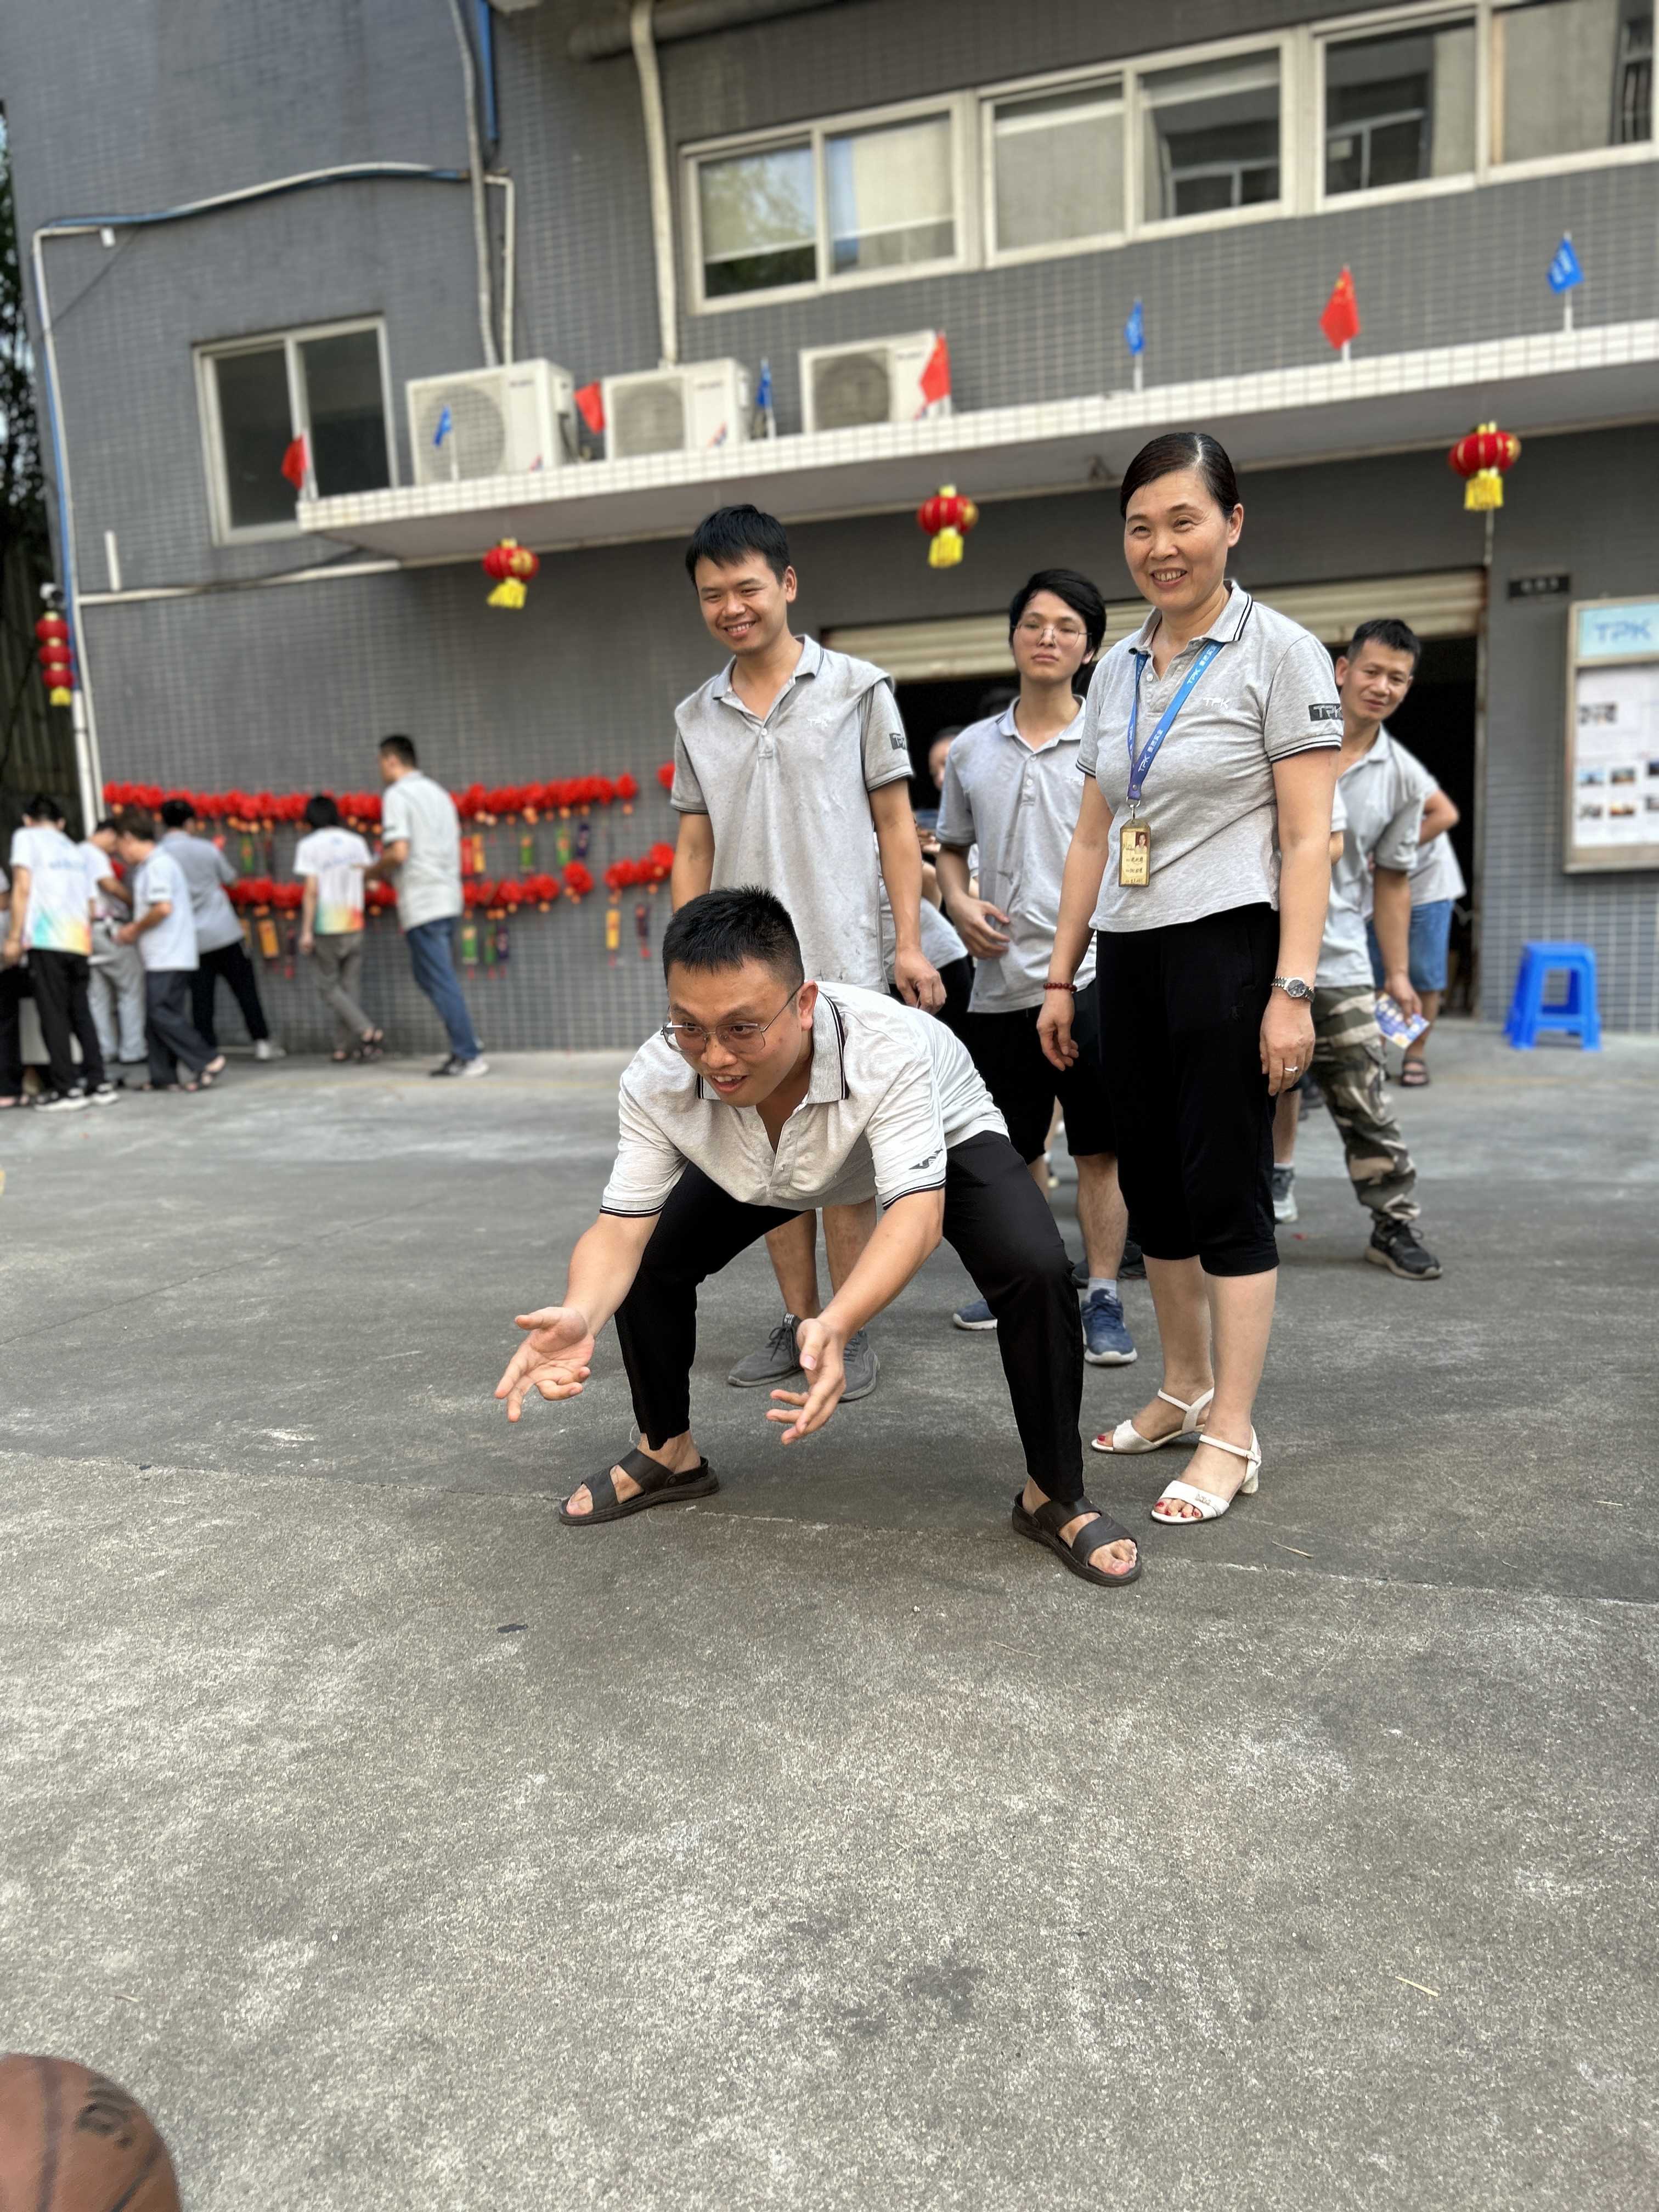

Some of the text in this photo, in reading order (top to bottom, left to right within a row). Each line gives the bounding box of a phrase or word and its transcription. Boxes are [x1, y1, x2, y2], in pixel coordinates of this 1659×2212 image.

[1595, 618, 1651, 643] TPK
[1187, 668, 1200, 684] TPK
[1203, 697, 1230, 709] TPK
[1138, 754, 1150, 772] TPK
